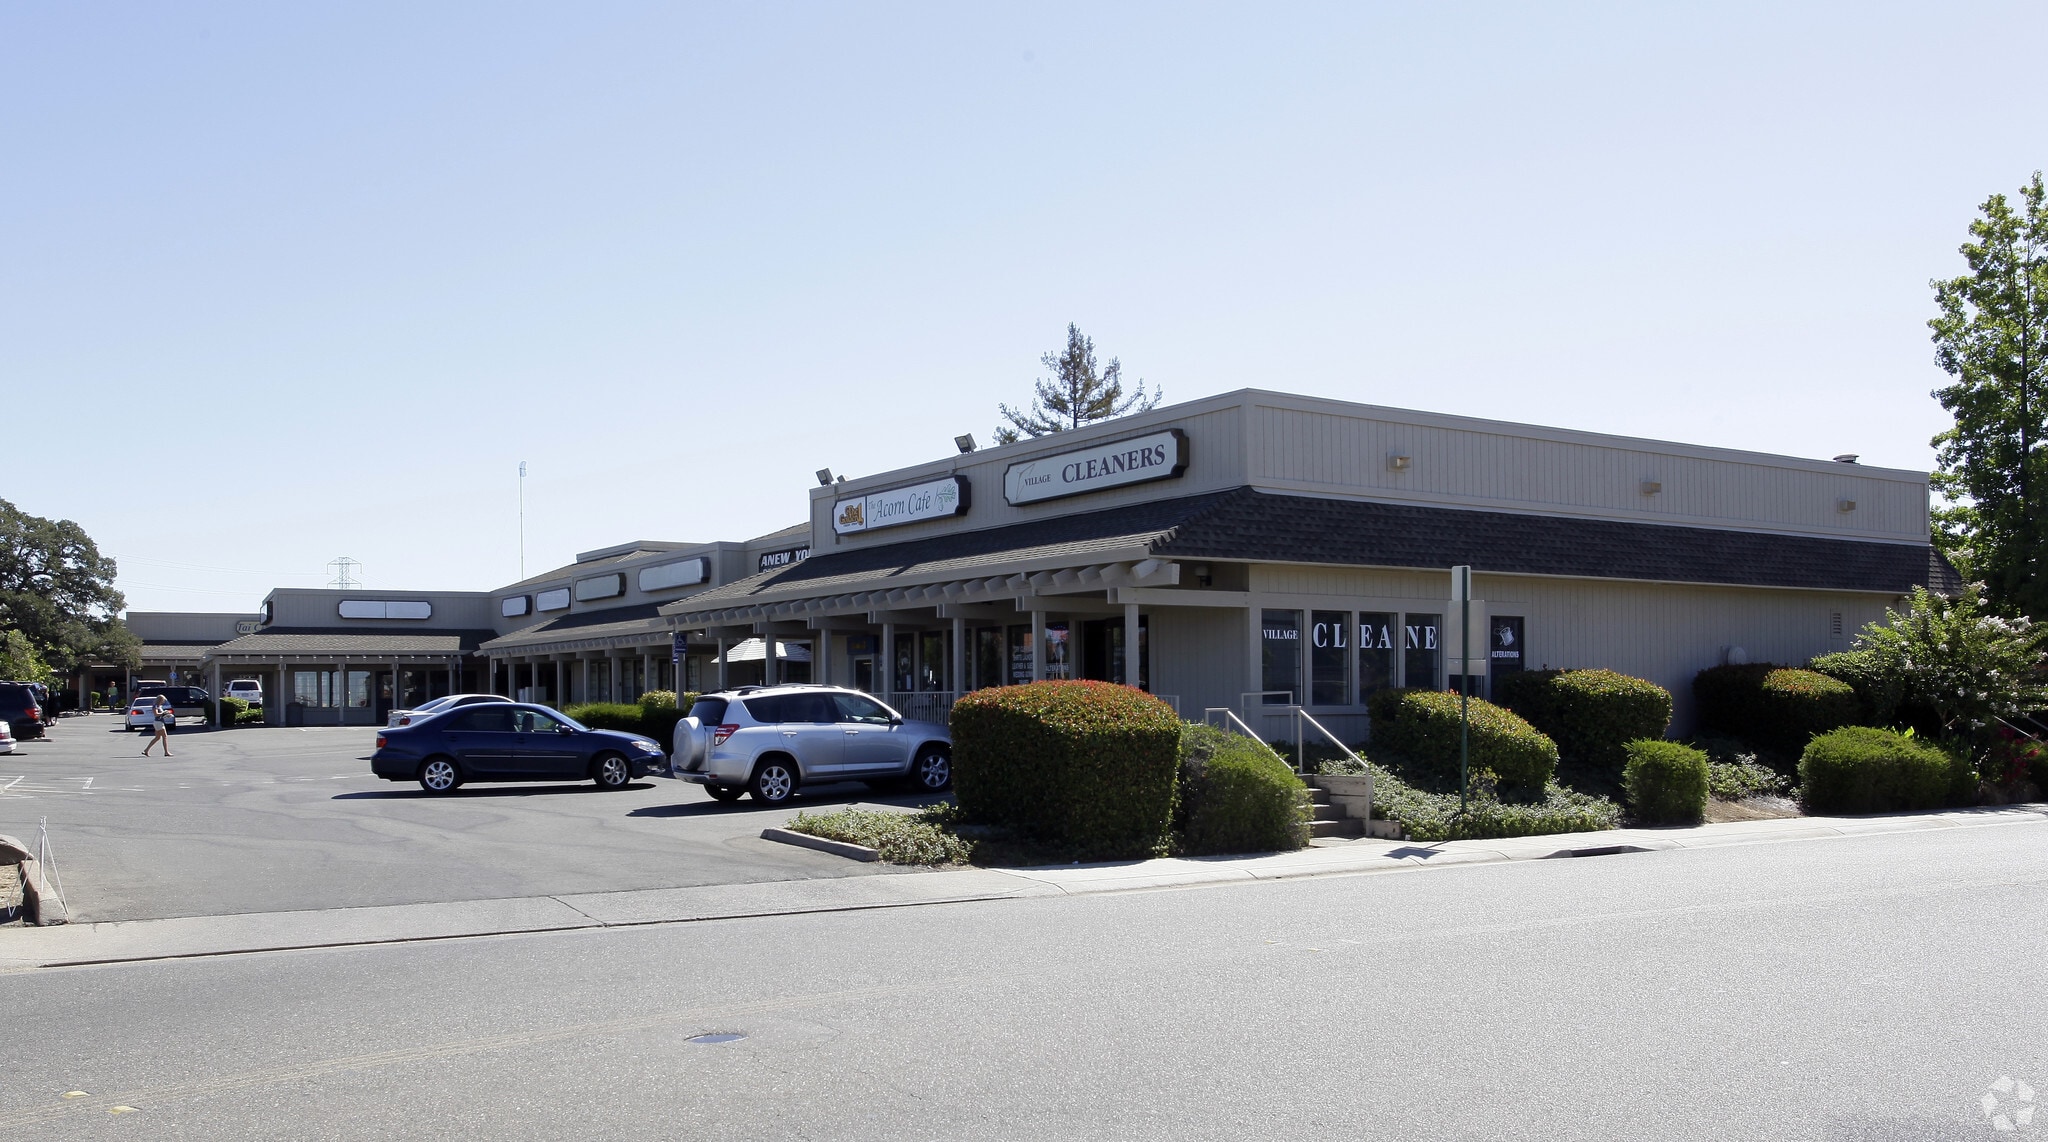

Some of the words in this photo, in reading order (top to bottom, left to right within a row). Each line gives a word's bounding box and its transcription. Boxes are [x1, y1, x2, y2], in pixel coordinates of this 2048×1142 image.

[1024, 474, 1051, 486] VILLAGE
[1062, 444, 1166, 483] CLEANERS
[873, 499, 905, 522] Acorn
[908, 491, 931, 515] Cafe
[761, 552, 790, 567] ANEW
[237, 623, 251, 632] Tai
[1263, 629, 1298, 640] VILLAGE
[1491, 650, 1520, 658] ALTERATIONS
